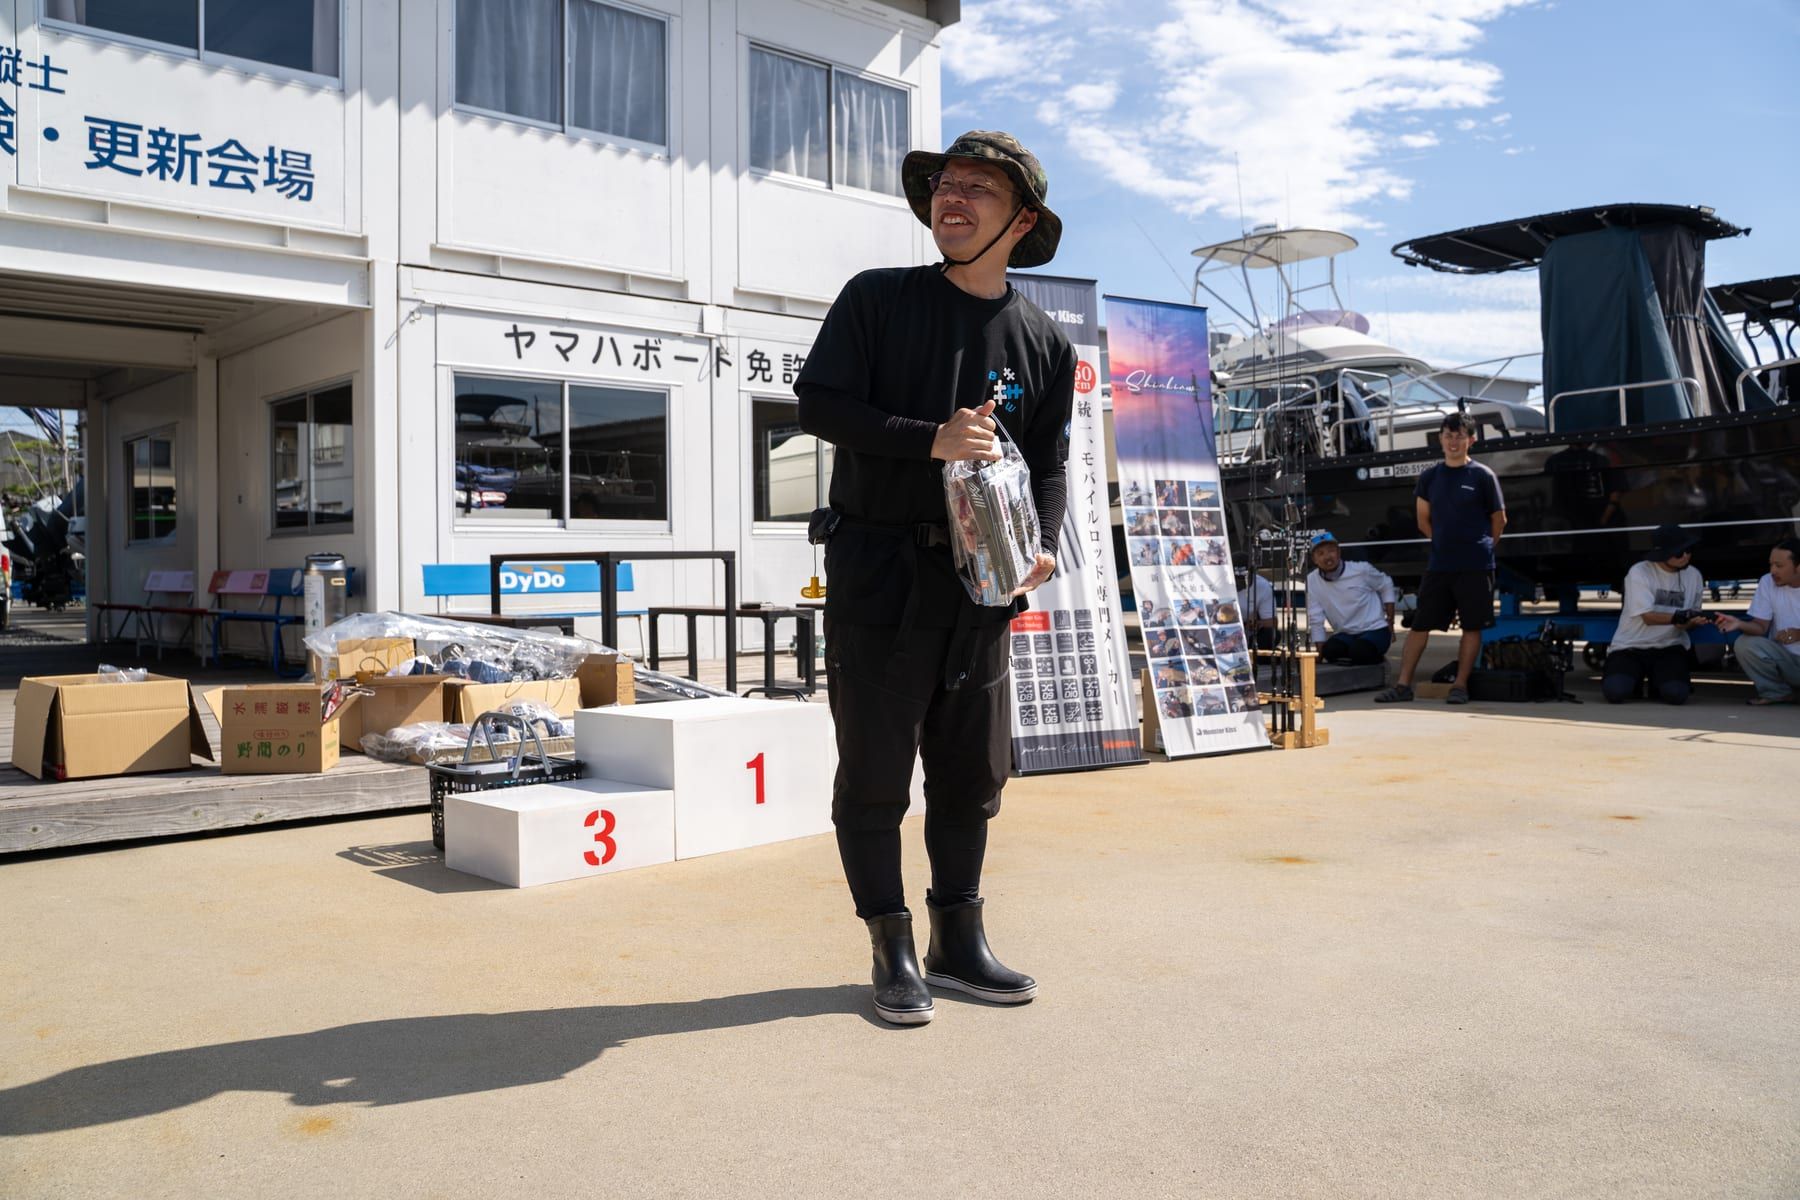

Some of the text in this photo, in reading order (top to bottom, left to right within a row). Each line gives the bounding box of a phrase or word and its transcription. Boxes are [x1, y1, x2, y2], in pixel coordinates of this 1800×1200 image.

[1058, 310, 1085, 325] Kiss
[499, 571, 566, 592] DyDo
[746, 752, 765, 804] 1
[583, 809, 617, 866] 3
